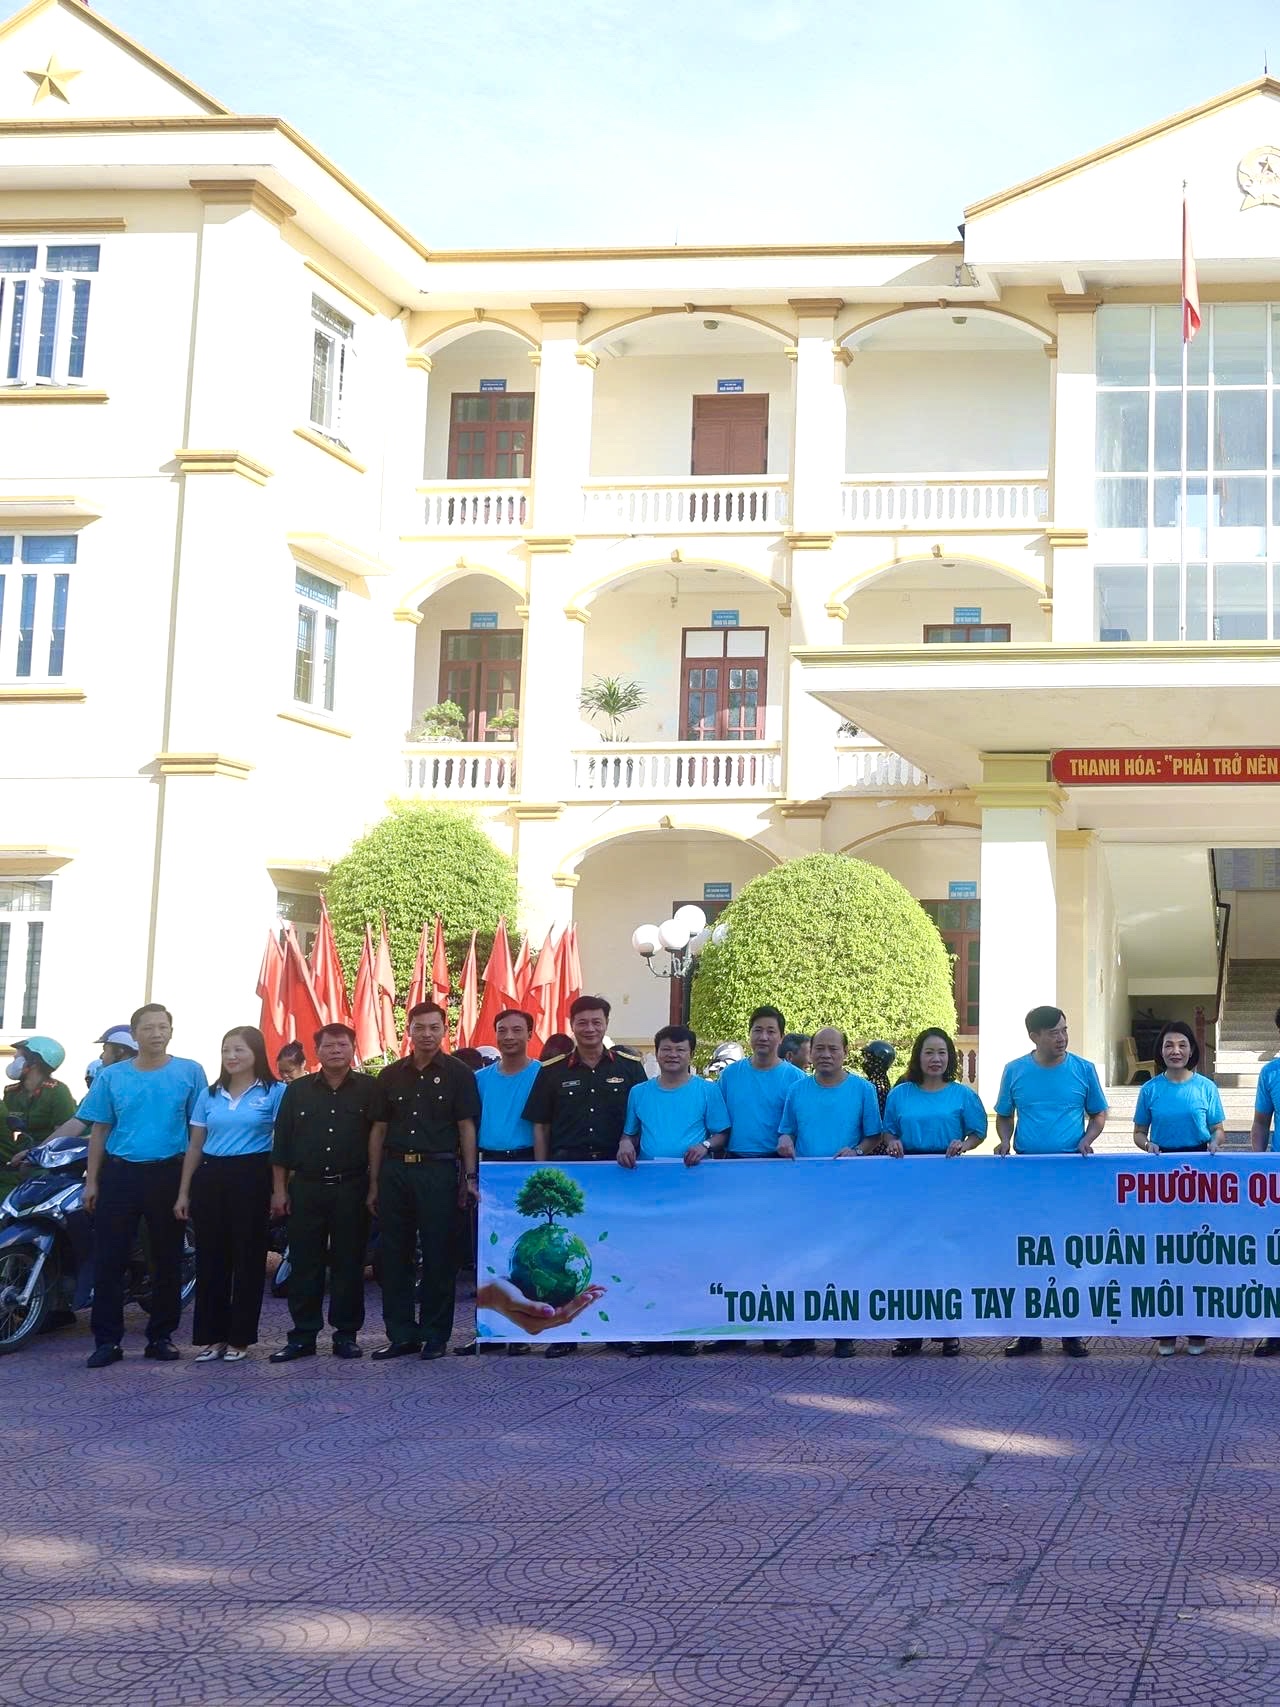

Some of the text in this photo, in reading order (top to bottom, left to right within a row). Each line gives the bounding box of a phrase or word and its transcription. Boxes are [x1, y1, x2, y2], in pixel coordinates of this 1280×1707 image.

[1070, 759, 1120, 776] THANH
[1125, 755, 1162, 776] HÓA:
[1213, 752, 1242, 775] TRỞ
[1246, 754, 1278, 775] NÊN
[1117, 1167, 1238, 1204] PHƯỜNG
[1017, 1236, 1056, 1266] RA
[1065, 1228, 1146, 1269] QUÂN
[1156, 1224, 1256, 1266] HƯỞNG
[804, 1283, 860, 1322] DÂN
[868, 1287, 963, 1322] CHUNG
[971, 1287, 1016, 1320] TAY
[1025, 1276, 1080, 1320] BẢO
[1089, 1280, 1122, 1325] VỆ
[1130, 1279, 1184, 1319] MÔI
